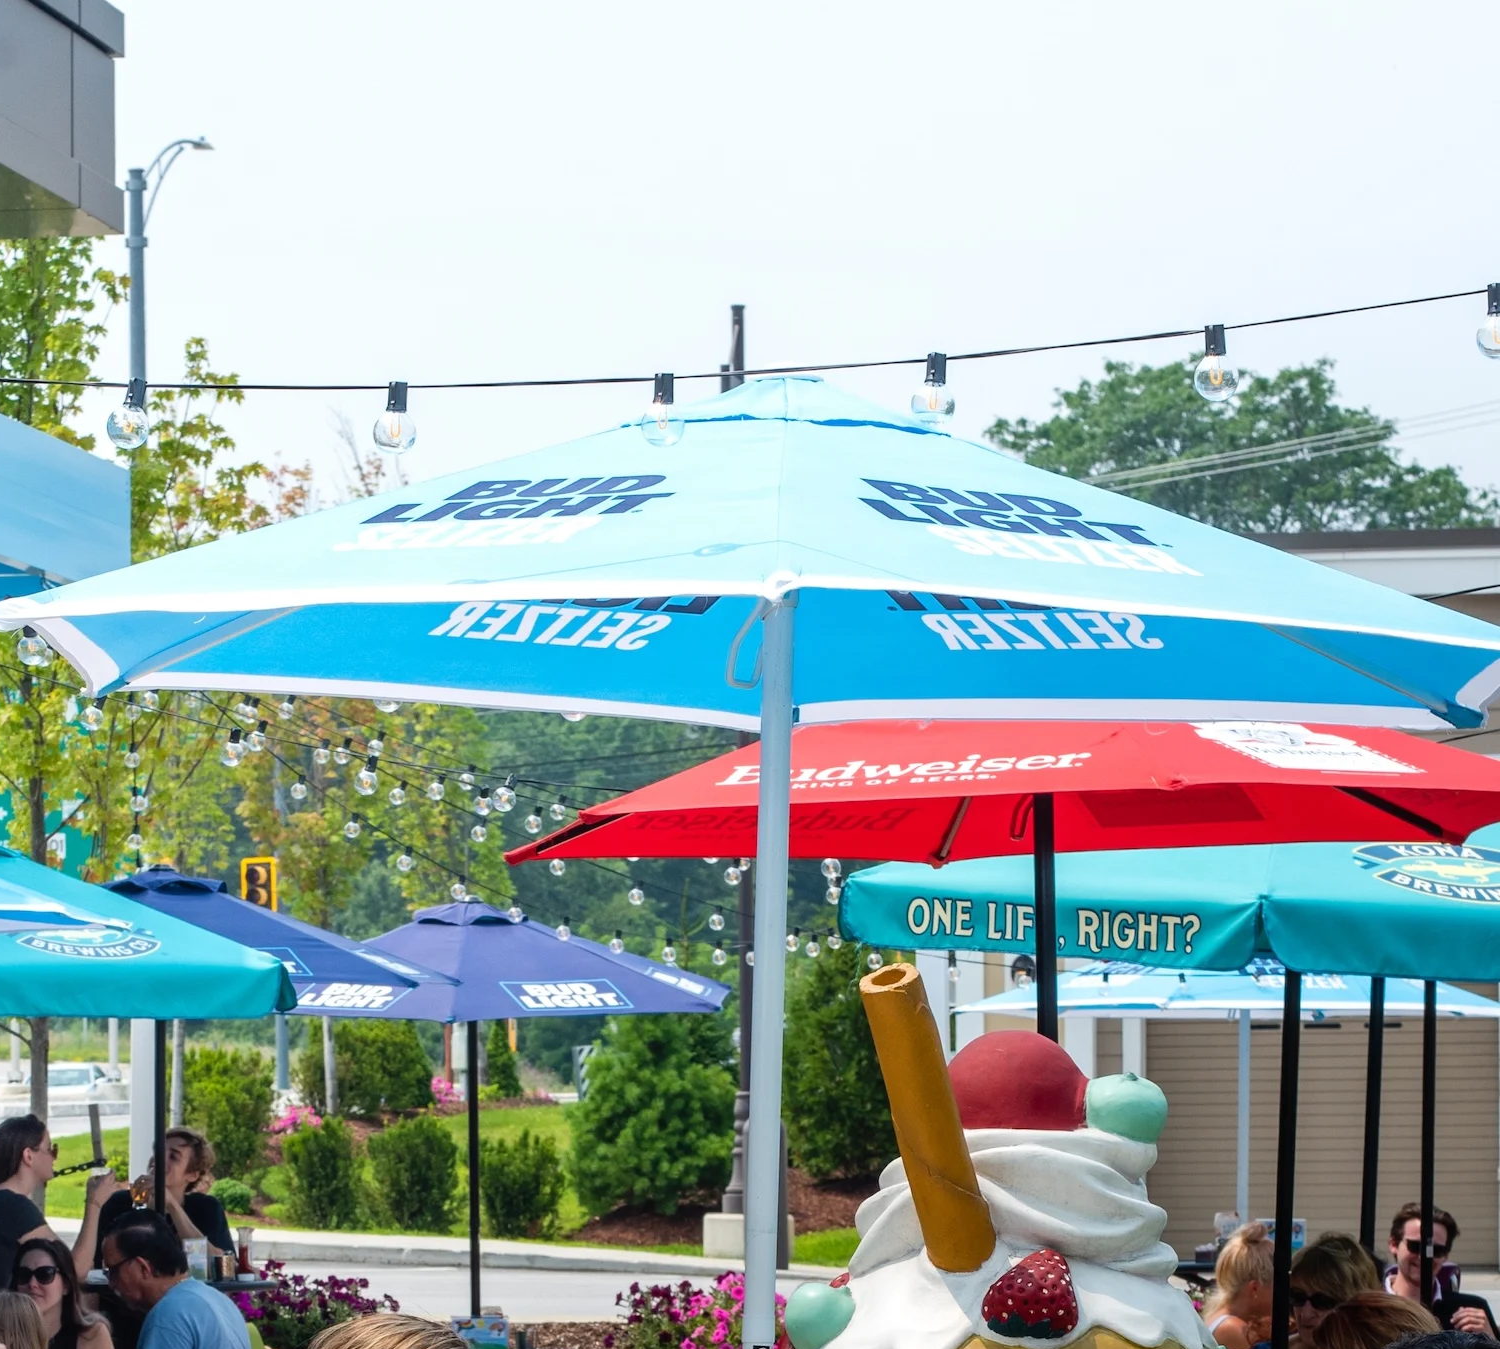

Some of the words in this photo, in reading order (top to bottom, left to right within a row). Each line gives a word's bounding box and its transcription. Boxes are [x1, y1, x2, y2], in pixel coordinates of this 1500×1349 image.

[445, 475, 667, 500] BUD
[860, 478, 1082, 517] BUD
[359, 493, 676, 524] LIGHT
[858, 497, 1160, 547] LIGHT
[925, 525, 1205, 577] SELTZER
[871, 778, 897, 786] OF
[1388, 845, 1484, 860] KONA
[907, 898, 974, 936] ONE
[987, 902, 1065, 949] LIF,
[1077, 909, 1200, 953] RIGHT?
[30, 938, 134, 957] BREWING
[302, 982, 393, 996] BUD
[521, 983, 597, 997] BUD
[297, 993, 394, 1008] LIGHT
[520, 993, 619, 1009] LIGHT
